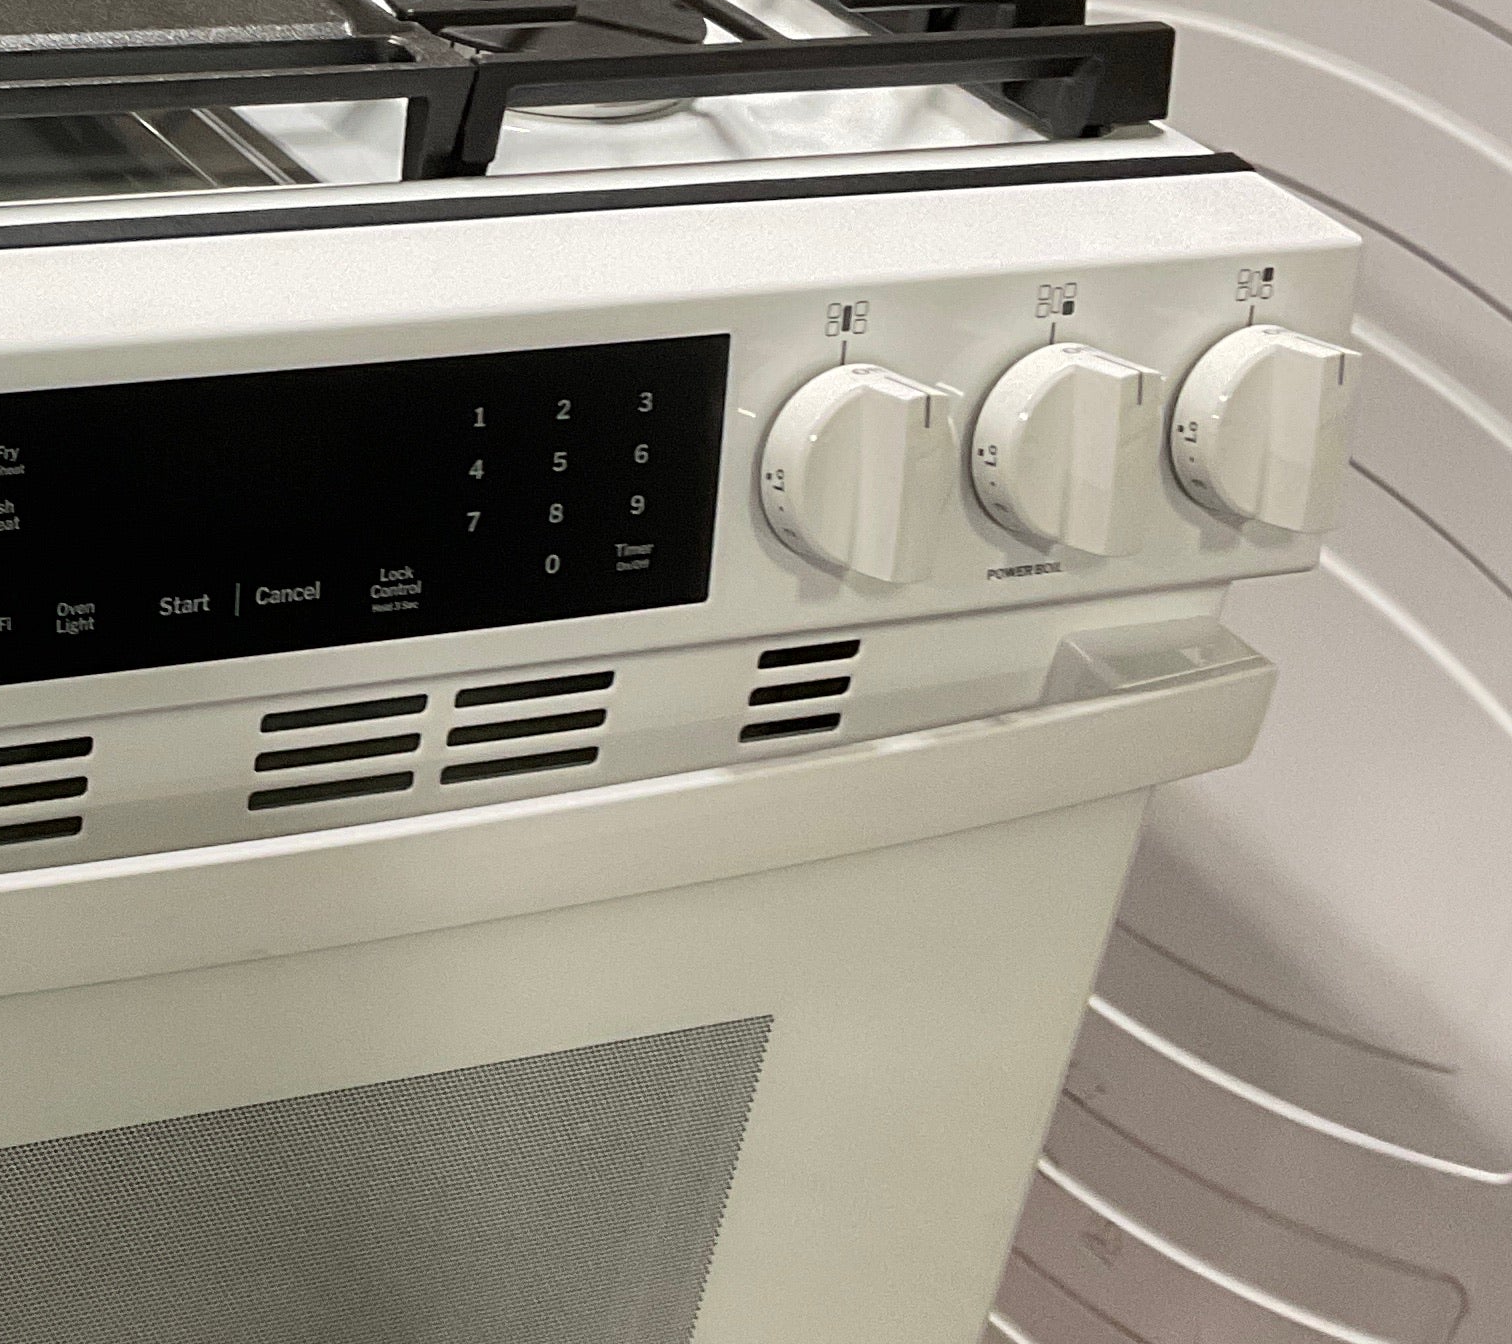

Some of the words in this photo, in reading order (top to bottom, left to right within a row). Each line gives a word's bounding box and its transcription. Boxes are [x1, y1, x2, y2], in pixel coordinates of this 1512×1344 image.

[556, 399, 571, 420] 2
[637, 391, 653, 413] 3
[473, 407, 486, 427] 1
[552, 451, 568, 472] 5
[634, 443, 649, 464] 6
[468, 459, 485, 480] 4
[548, 503, 564, 524] 8
[629, 494, 645, 515] 9
[466, 511, 481, 532] 7
[379, 565, 414, 582] Lock
[545, 554, 561, 574] 0
[987, 564, 1033, 581] POWER
[159, 593, 211, 616] Start
[255, 580, 321, 605] Cancel
[369, 579, 422, 599] Control
[56, 602, 96, 617] Oven
[56, 615, 95, 635] Light
